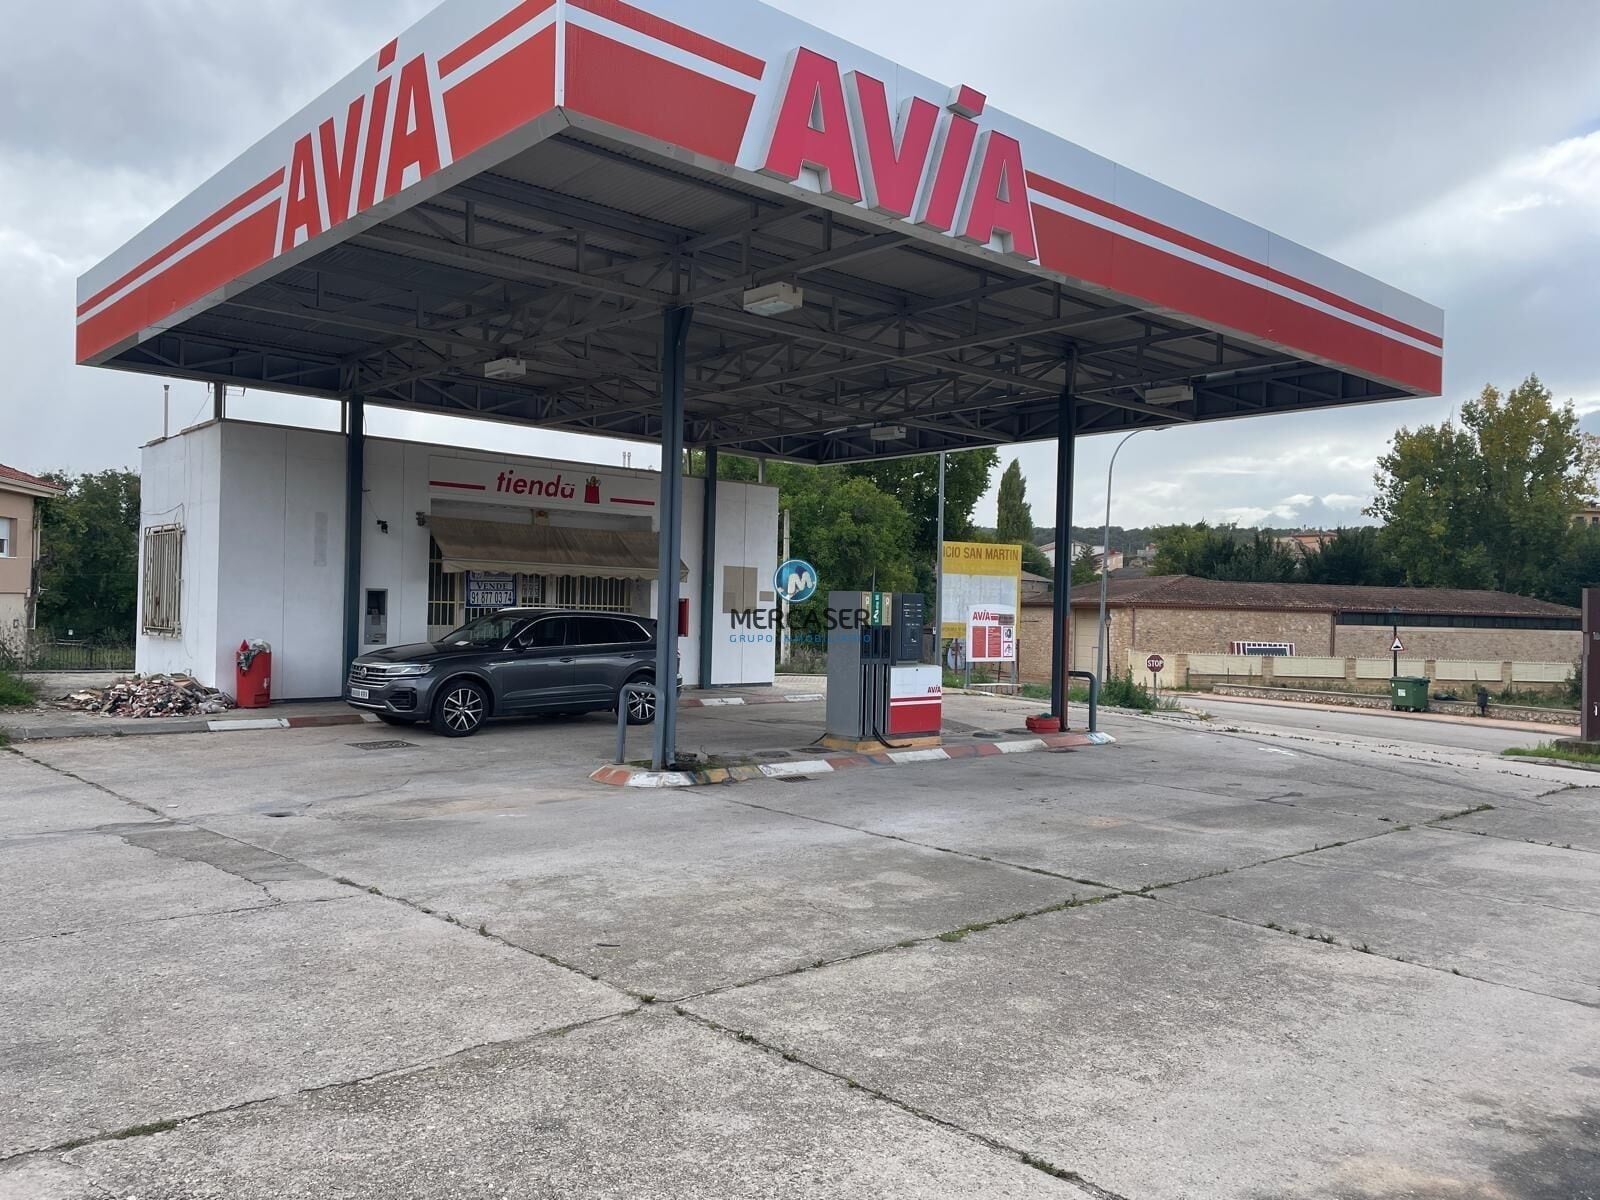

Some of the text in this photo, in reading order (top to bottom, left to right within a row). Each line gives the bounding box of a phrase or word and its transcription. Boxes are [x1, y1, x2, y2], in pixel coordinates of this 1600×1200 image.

[281, 37, 442, 254] AVIA
[758, 46, 1037, 260] AVIA
[963, 547, 982, 560] SAN
[985, 548, 1019, 561] MARTIN
[477, 582, 508, 590] VENDE
[471, 591, 479, 603] 91
[494, 591, 503, 603] 03
[504, 591, 512, 603] 74
[972, 609, 991, 621] AVIA
[927, 684, 942, 694] AVIA
